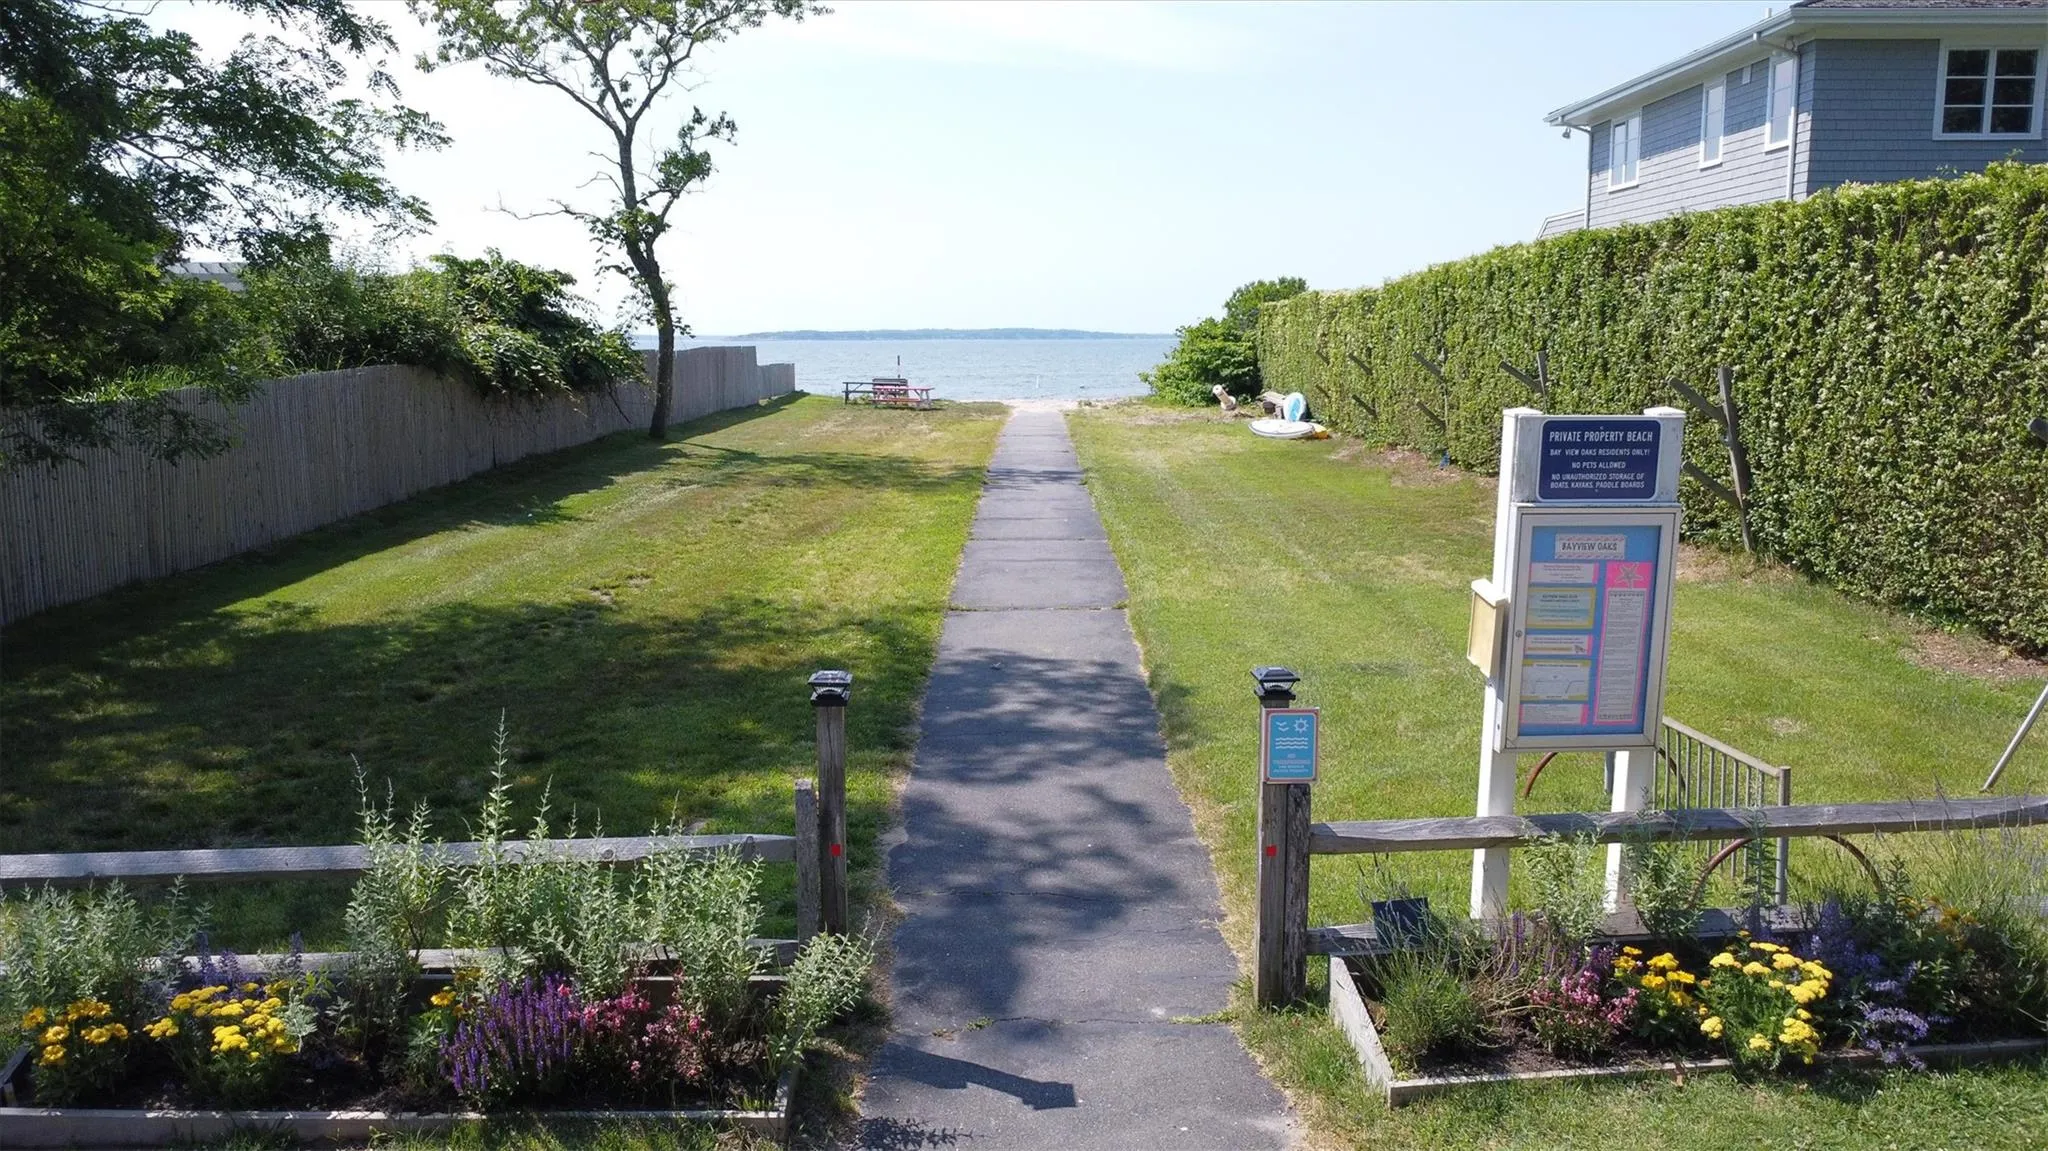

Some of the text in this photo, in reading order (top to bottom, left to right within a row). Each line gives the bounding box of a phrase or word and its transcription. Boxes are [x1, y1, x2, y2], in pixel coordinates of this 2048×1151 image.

[1549, 431, 1653, 442] PRIVATE PROPERTY BEACH
[1561, 542, 1617, 551] BAYVIEW OAKS
